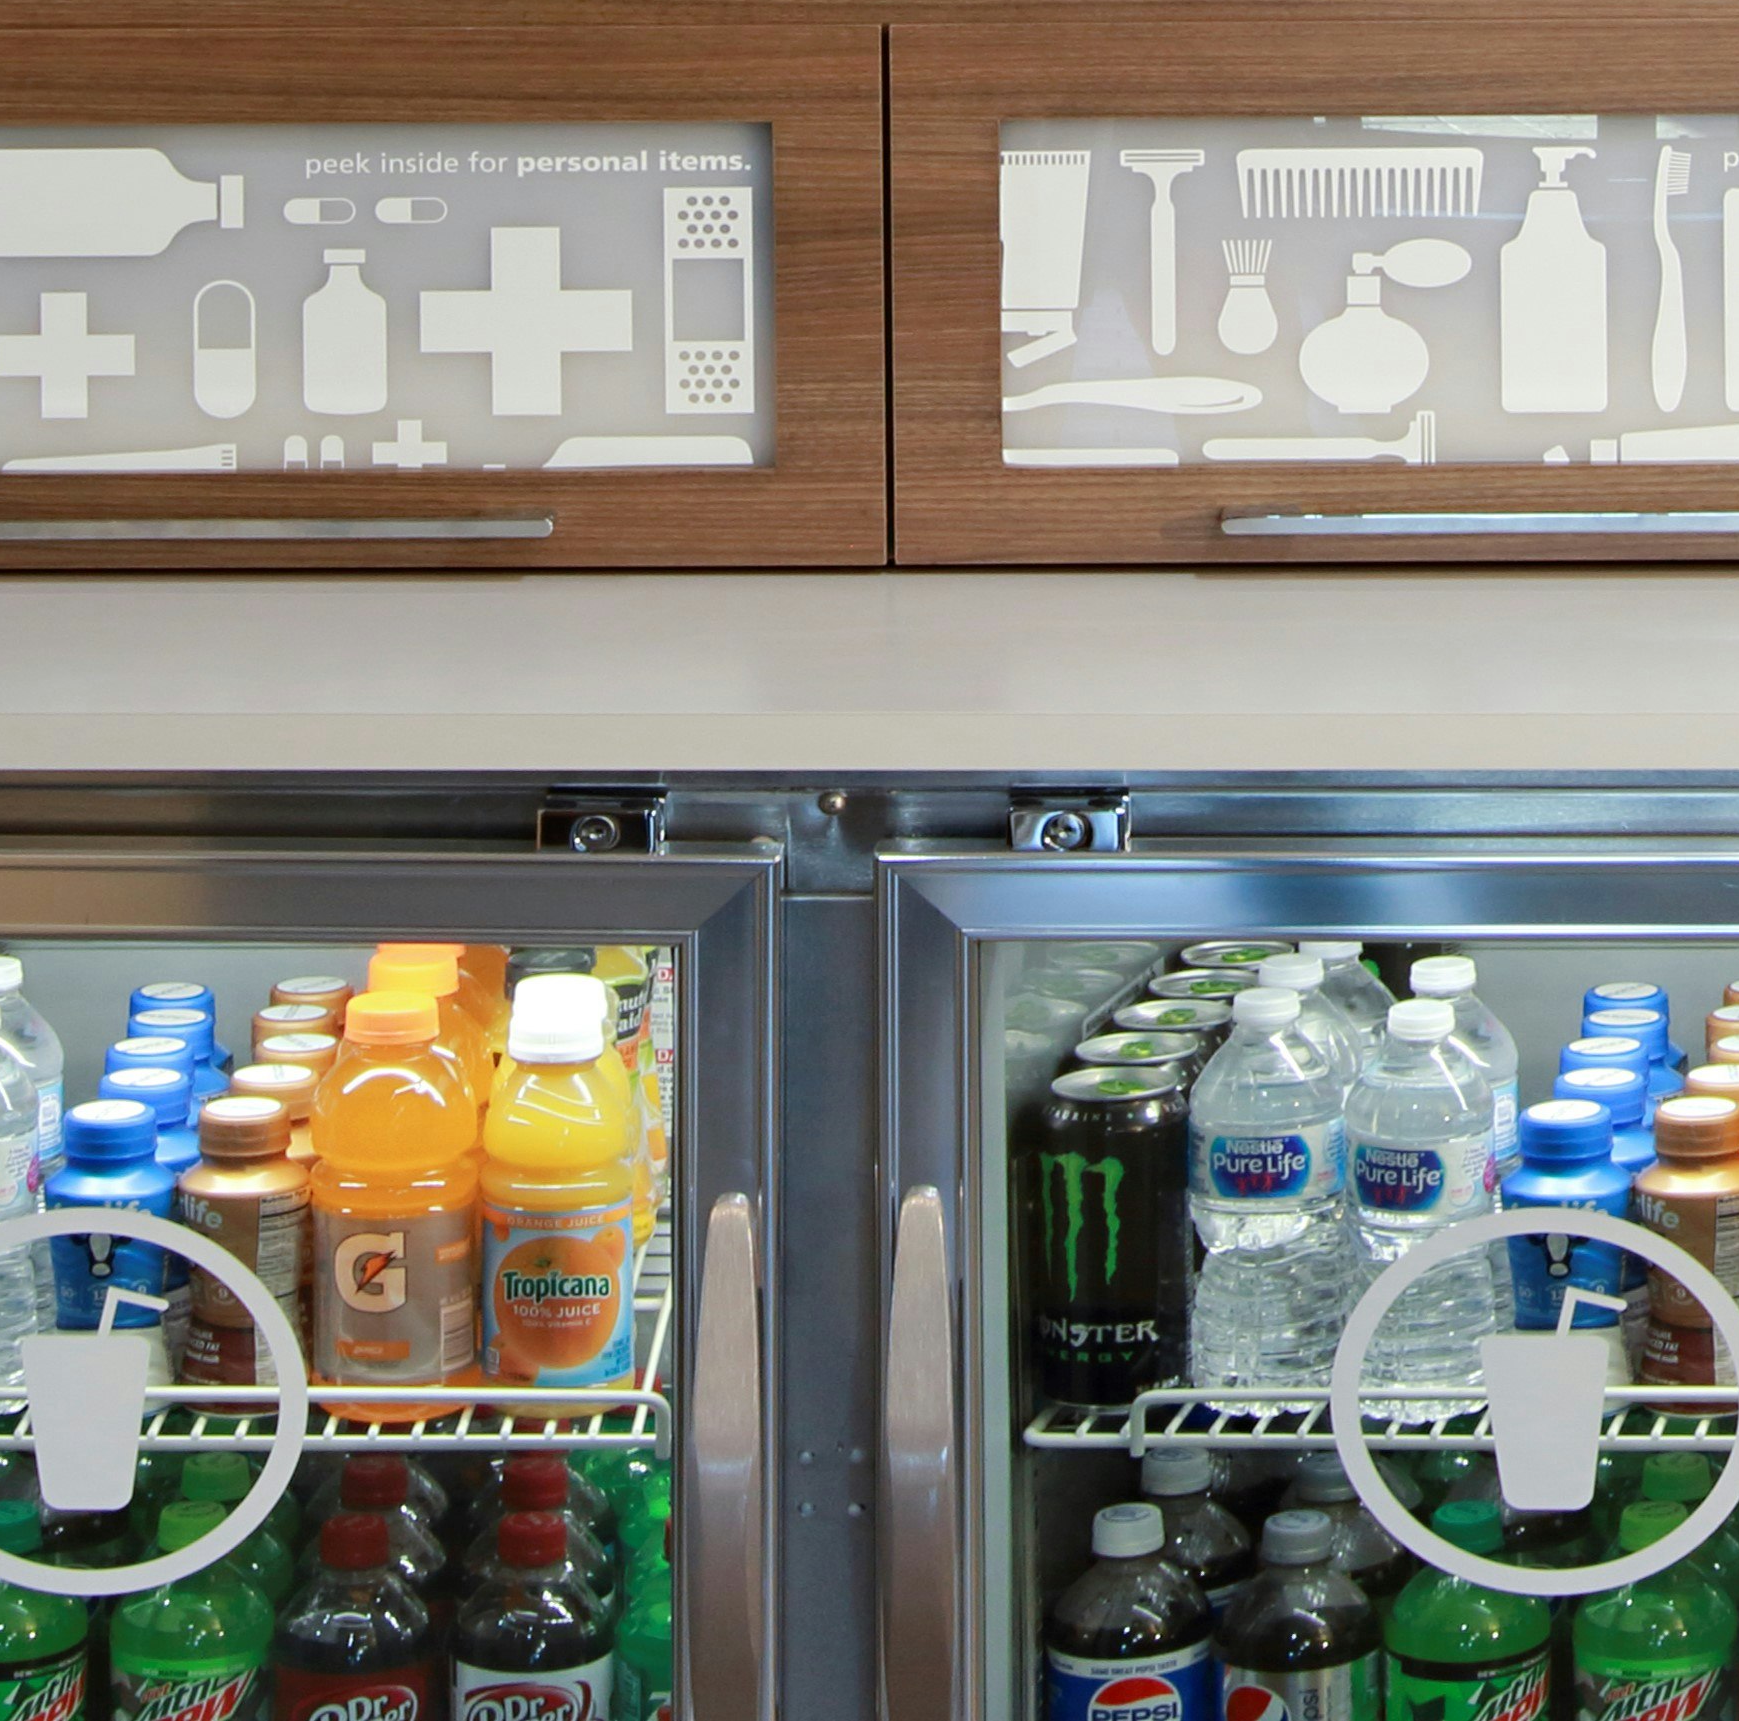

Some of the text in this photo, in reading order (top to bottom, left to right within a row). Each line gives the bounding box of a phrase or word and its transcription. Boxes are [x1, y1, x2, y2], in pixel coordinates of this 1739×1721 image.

[305, 149, 752, 179] peek inside for personal items.
[1213, 1152, 1307, 1179] Pure Life
[1356, 1160, 1442, 1194] Pure Life
[567, 1214, 605, 1227] JUICE
[334, 1231, 408, 1314] G
[502, 1270, 611, 1304] Tropicana
[513, 1303, 601, 1318] 100% JUICE
